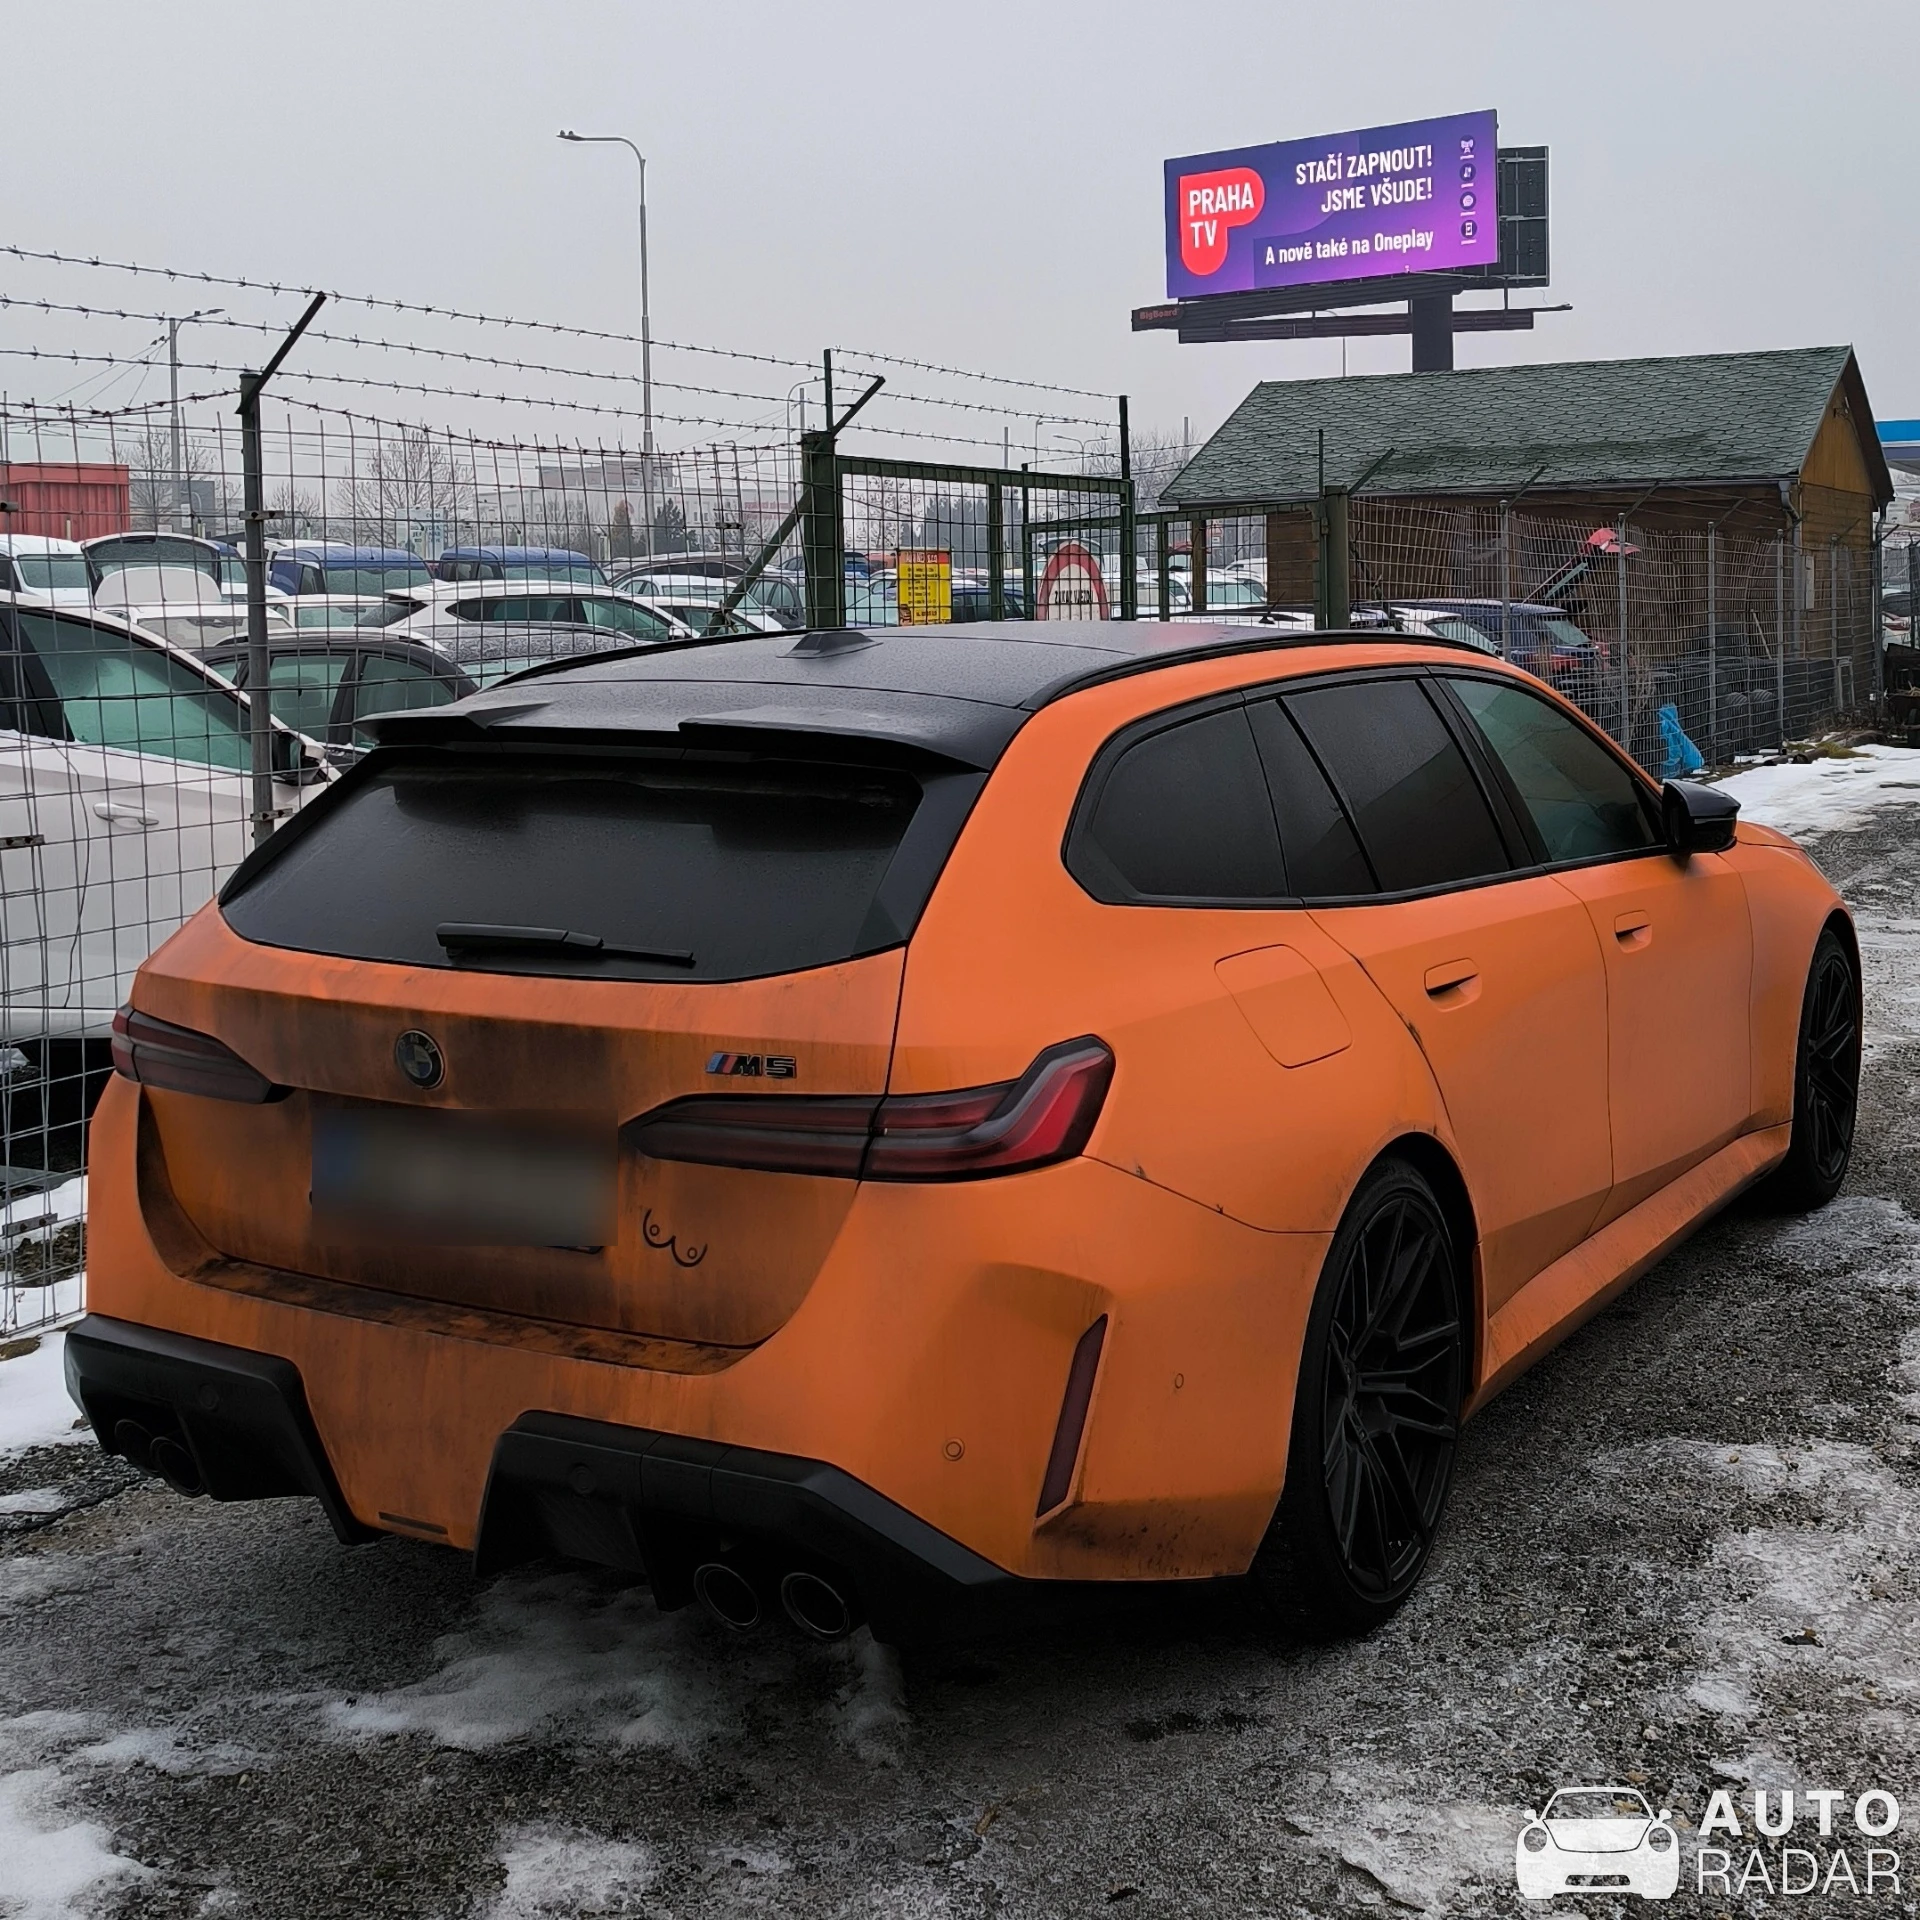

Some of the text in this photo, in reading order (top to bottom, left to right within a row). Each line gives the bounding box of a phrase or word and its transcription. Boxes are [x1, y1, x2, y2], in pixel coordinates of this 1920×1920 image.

[1296, 144, 1433, 185] STAČÍ ZAPNOUT!
[1189, 182, 1255, 217] PRAHA
[1321, 177, 1433, 213] JSME VŠUDE!
[1190, 219, 1217, 249] TV
[1265, 228, 1434, 265] A nově také na Oneplay
[728, 1052, 797, 1078] M5
